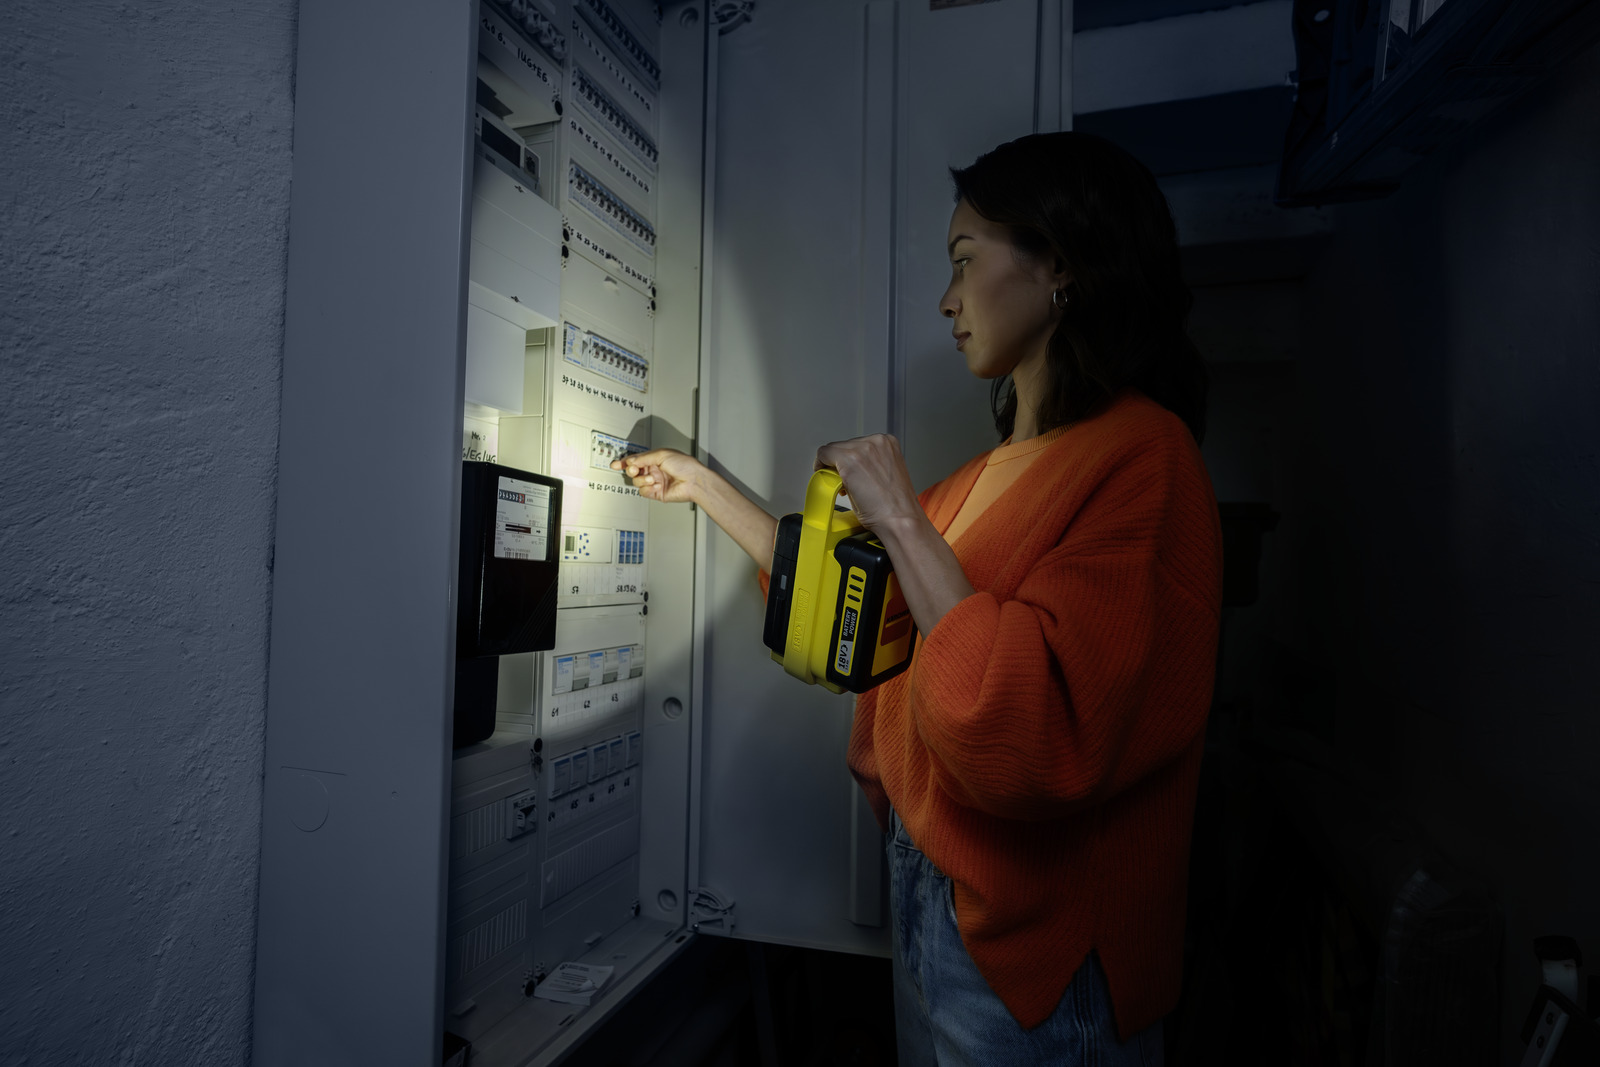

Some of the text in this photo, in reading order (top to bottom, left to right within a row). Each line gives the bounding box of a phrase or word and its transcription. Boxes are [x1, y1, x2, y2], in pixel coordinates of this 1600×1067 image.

[842, 610, 852, 637] BATTERY
[848, 612, 857, 635] POWER
[552, 707, 558, 718] 61
[584, 700, 590, 709] 62
